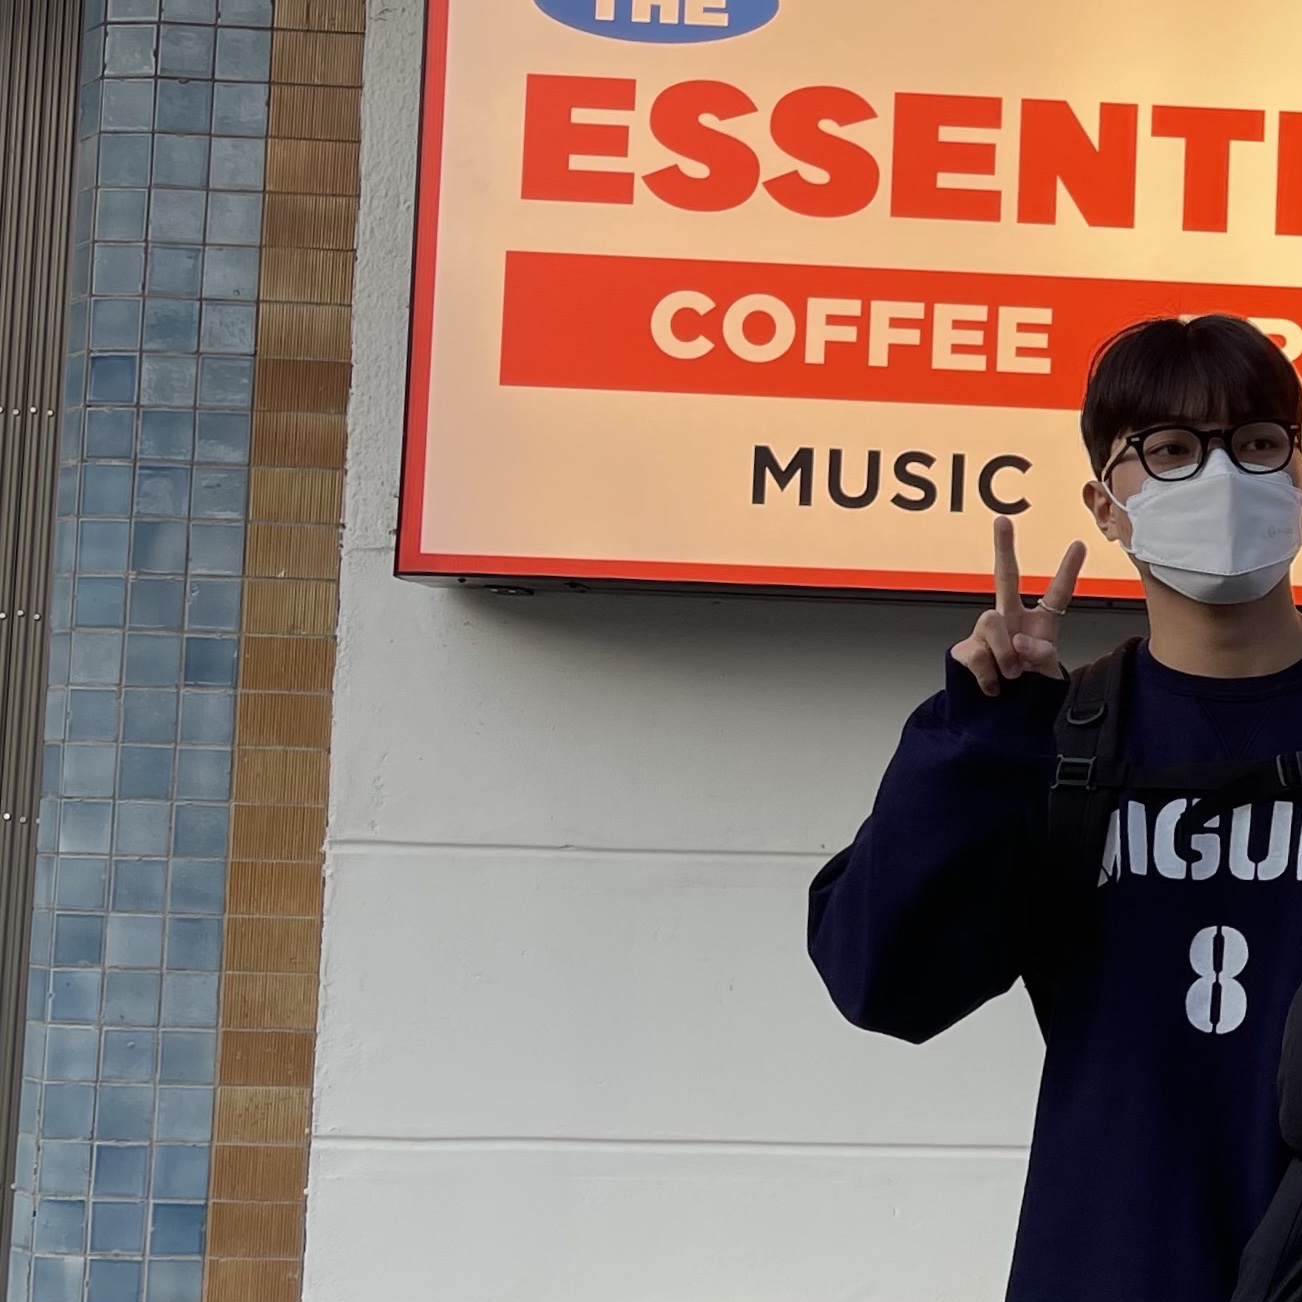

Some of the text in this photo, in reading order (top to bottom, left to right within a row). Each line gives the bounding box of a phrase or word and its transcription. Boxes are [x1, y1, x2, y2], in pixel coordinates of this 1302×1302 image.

[650, 290, 1053, 374] COFFEE
[752, 445, 1032, 514] MUSIC
[1185, 925, 1249, 1035] 8
